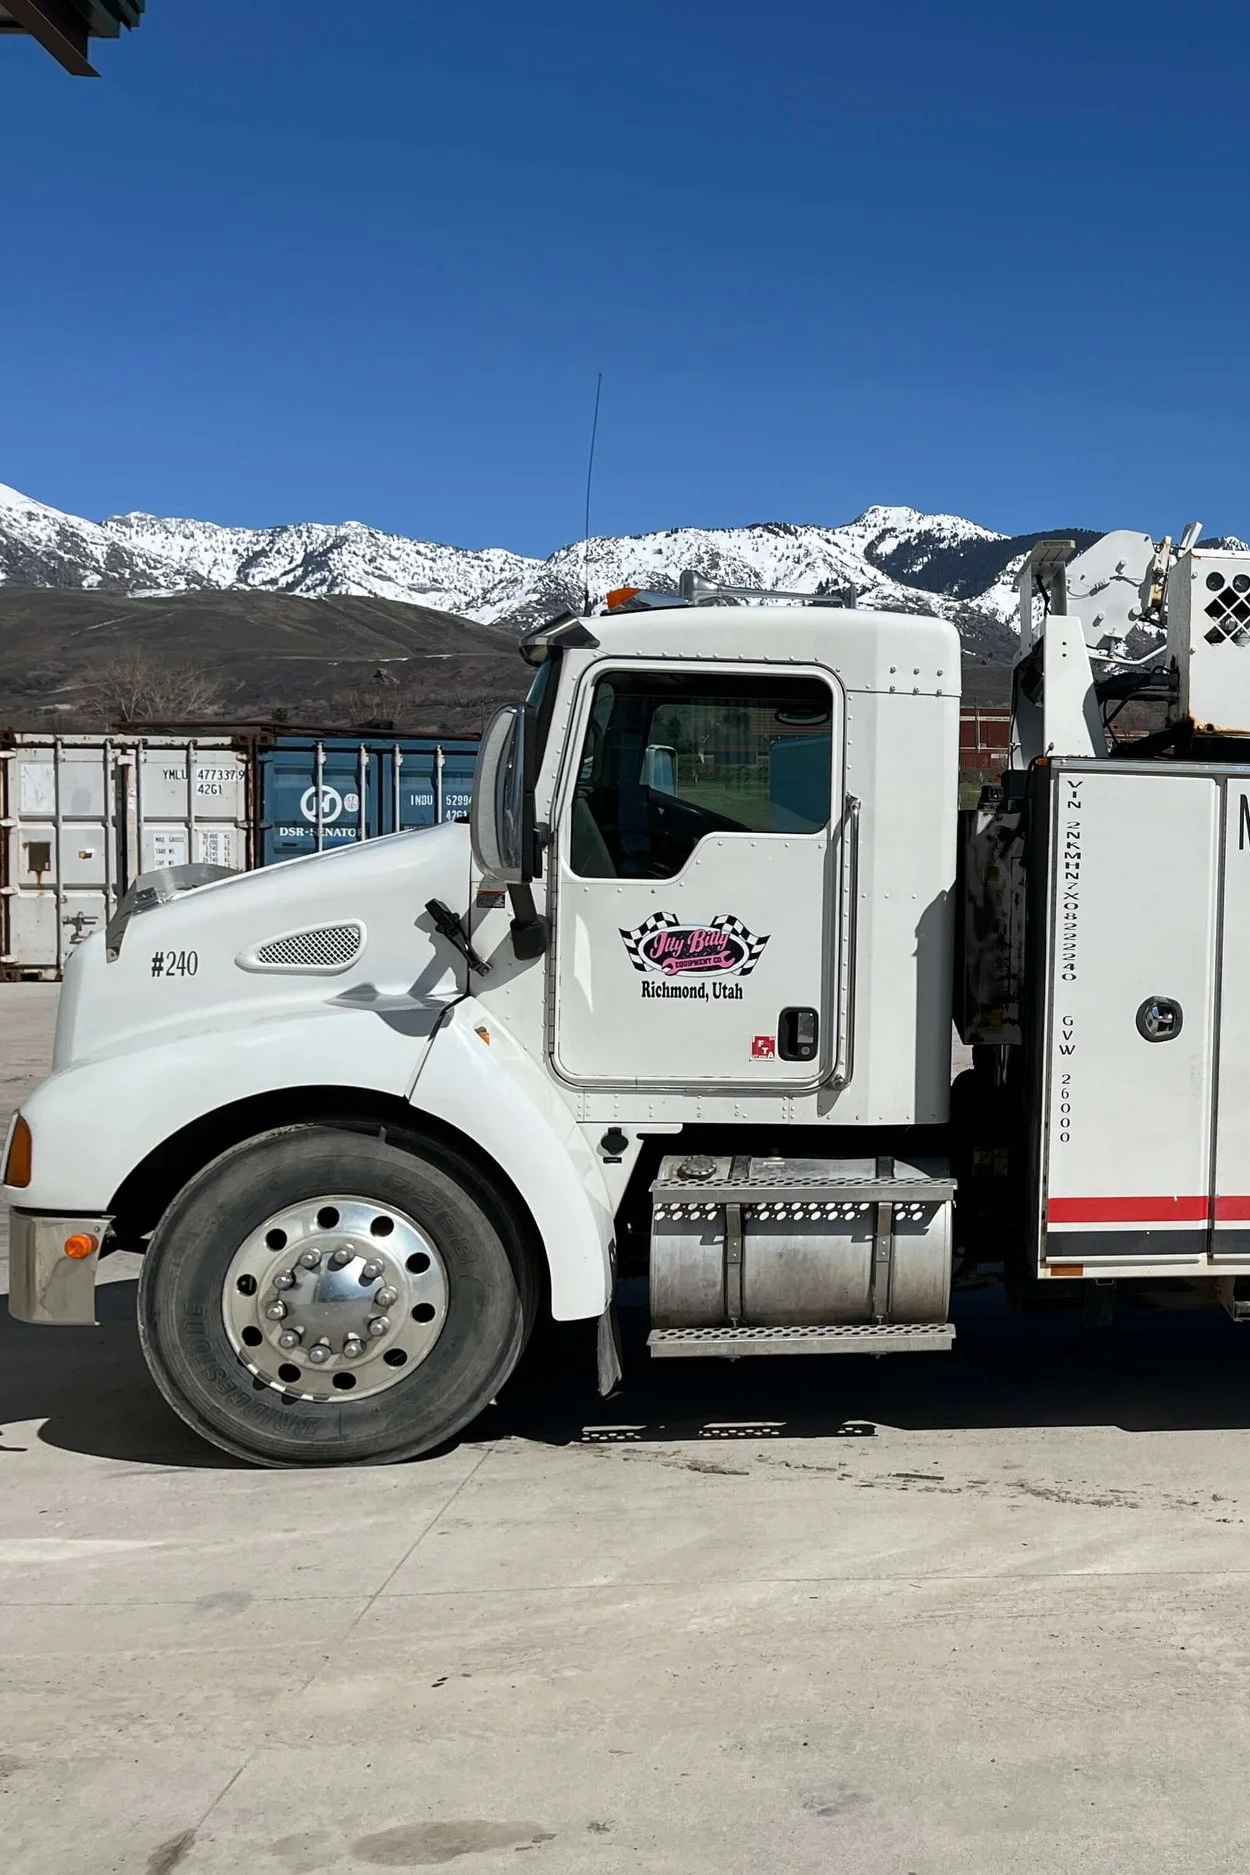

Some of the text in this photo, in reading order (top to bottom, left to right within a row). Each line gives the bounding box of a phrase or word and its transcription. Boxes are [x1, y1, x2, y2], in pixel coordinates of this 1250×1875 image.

[162, 769, 188, 780] YMLU
[197, 783, 223, 795] 42G1
[1067, 780, 1084, 809] VIN
[687, 929, 729, 952] Bitty
[151, 950, 198, 978] #240
[675, 957, 712, 969] EQUIPMENT
[641, 981, 744, 1002] Richmond, Utah
[1059, 1015, 1076, 1056] GVW
[1059, 1073, 1072, 1143] 26000
[184, 1302, 327, 1437] BRIDGESTONE
